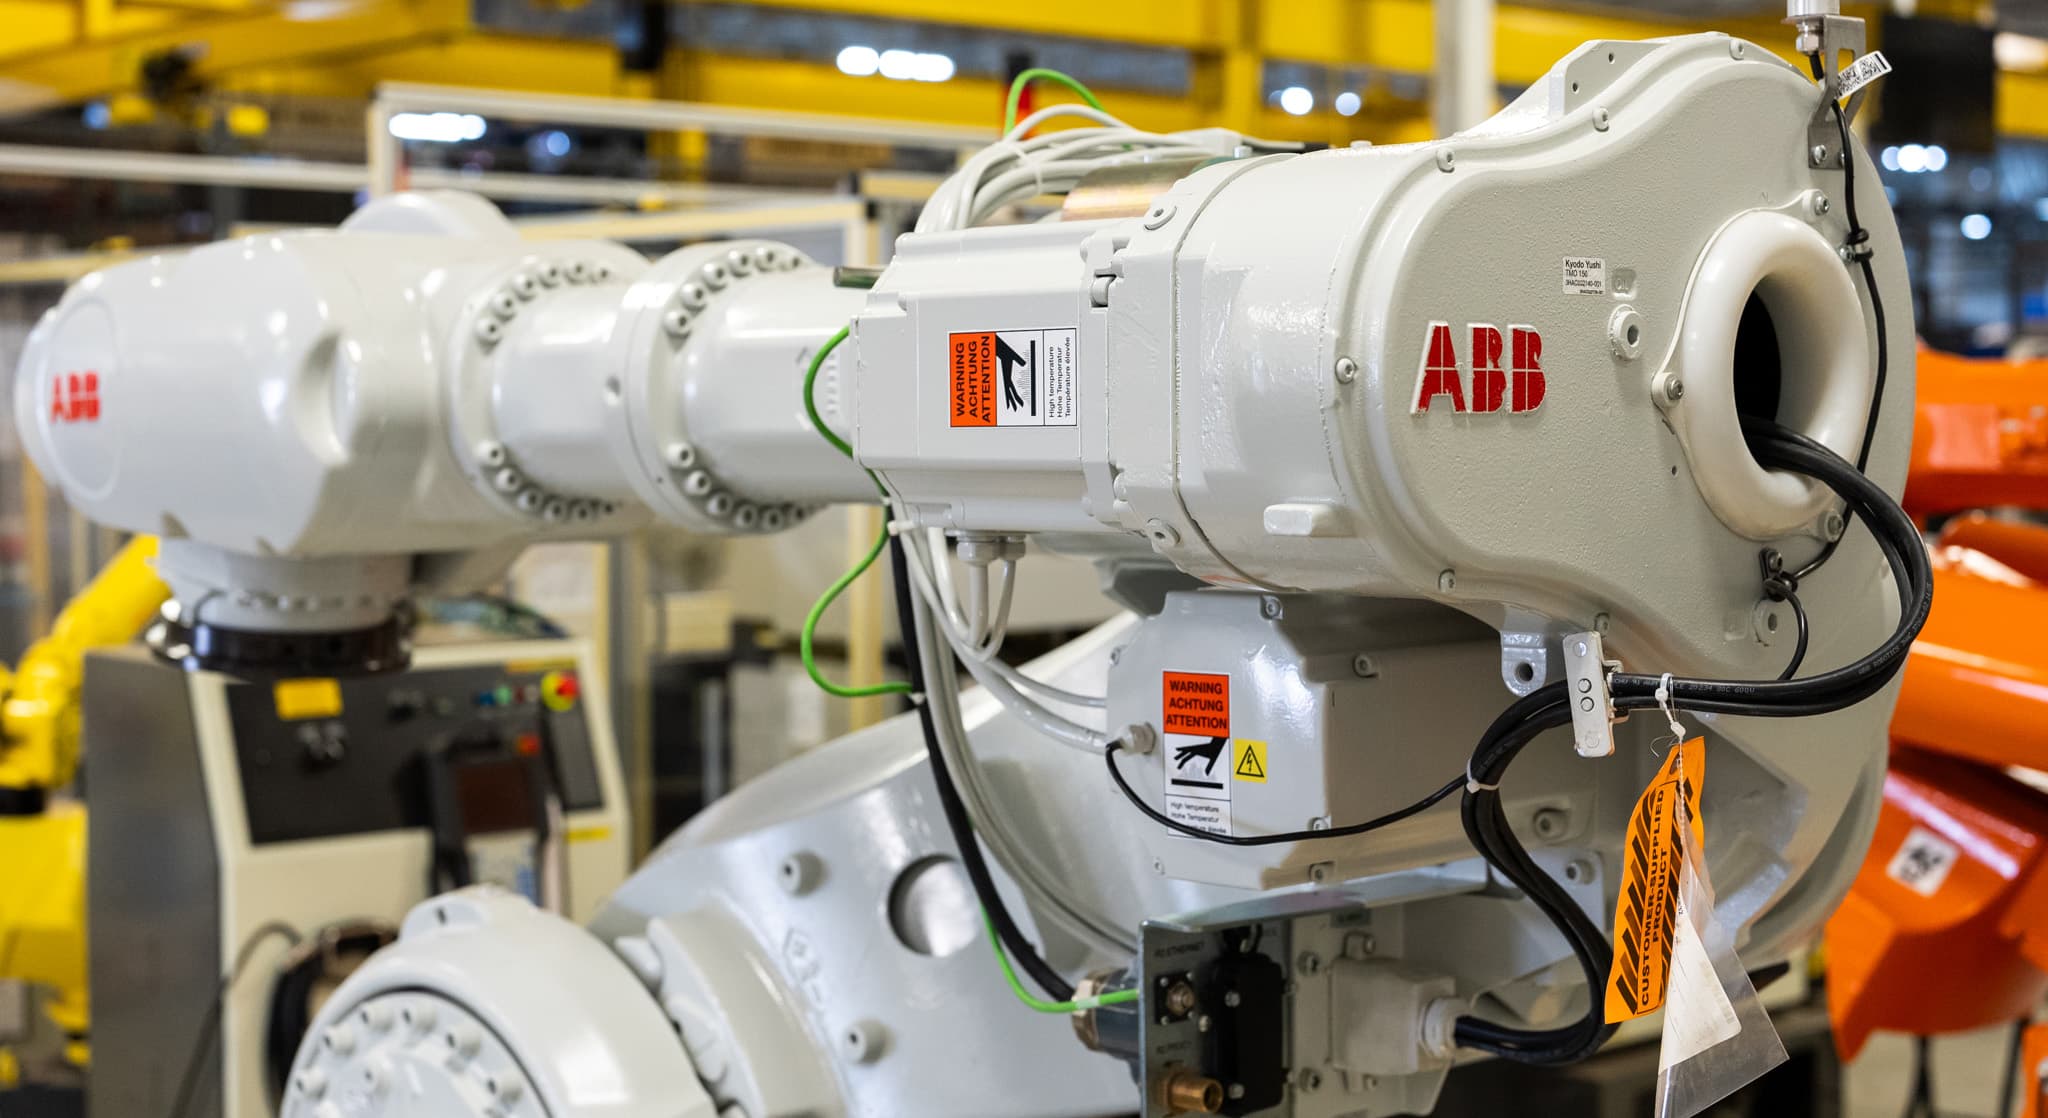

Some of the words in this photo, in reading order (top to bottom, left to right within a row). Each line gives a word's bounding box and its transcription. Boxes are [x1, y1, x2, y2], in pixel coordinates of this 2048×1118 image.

[1566, 260, 1584, 269] Kyodo
[1586, 260, 1601, 269] Yushi
[50, 372, 100, 422] ABB
[956, 342, 964, 416] WARNING
[968, 341, 977, 418] ACHTUNG
[981, 336, 990, 423] ATTENTION
[1411, 320, 1546, 414] ABB
[1166, 714, 1227, 729] ATTENTION
[1169, 680, 1222, 694] WARNING
[1169, 697, 1224, 712] ACHTUNG
[1642, 789, 1664, 1006] CUSTOMER-SUPPLIED
[1652, 850, 1667, 943] PRODUCT
